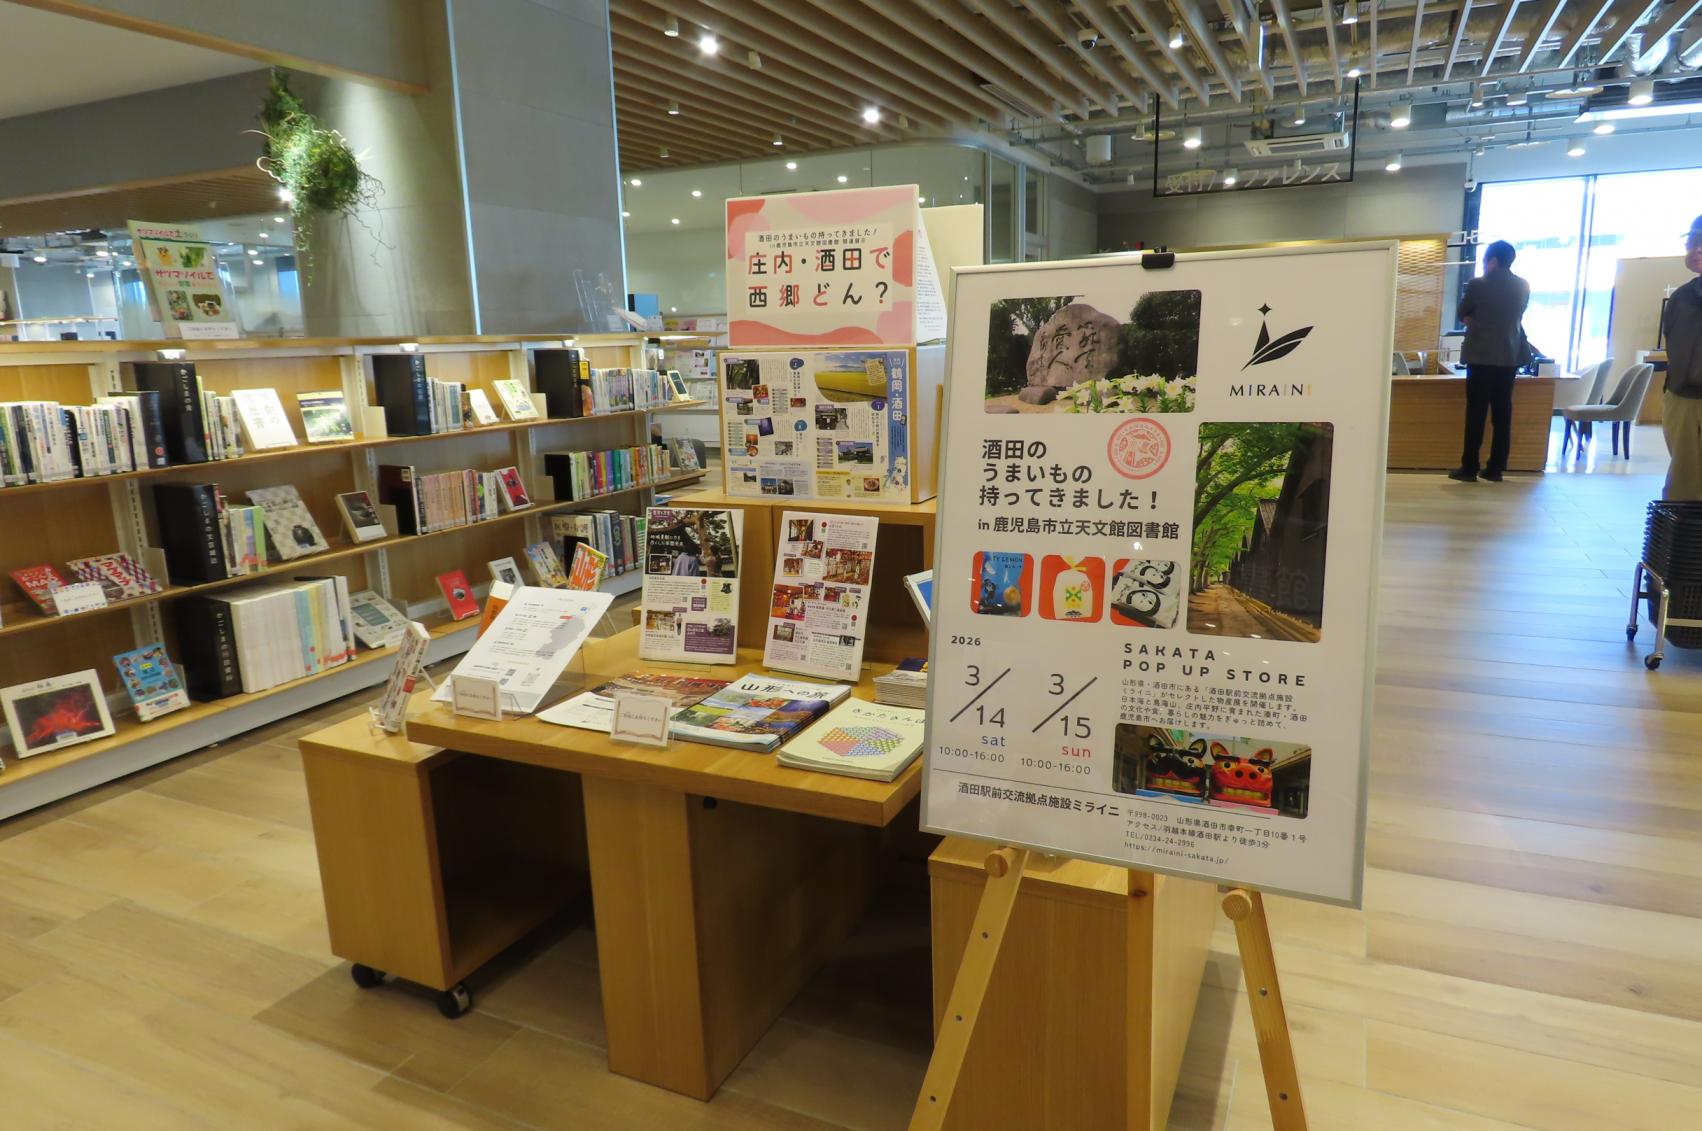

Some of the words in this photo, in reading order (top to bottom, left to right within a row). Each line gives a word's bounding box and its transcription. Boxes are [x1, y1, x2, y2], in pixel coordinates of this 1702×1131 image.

[748, 246, 890, 275] 庄内・酒田で
[748, 281, 889, 308] 西郷どん?
[1229, 383, 1313, 398] MIRAINI
[982, 439, 1047, 460] 酒田の
[982, 463, 1092, 484] うまいもの
[979, 486, 1159, 510] 持ってきました!
[994, 517, 1180, 540] 鹿児島市立天文館図書館
[951, 635, 981, 646] 2026
[1124, 643, 1215, 661] SAKATA
[1123, 659, 1166, 673] POP
[1182, 664, 1210, 677] UP
[1226, 668, 1306, 687] STORE
[981, 735, 1006, 747] sat
[939, 746, 1005, 763] 10:00-16:00
[1061, 746, 1091, 758] sun
[1021, 758, 1091, 775] 10:00-16:00
[958, 782, 1120, 817] 酒田駅前交流拠点施設ミライニ
